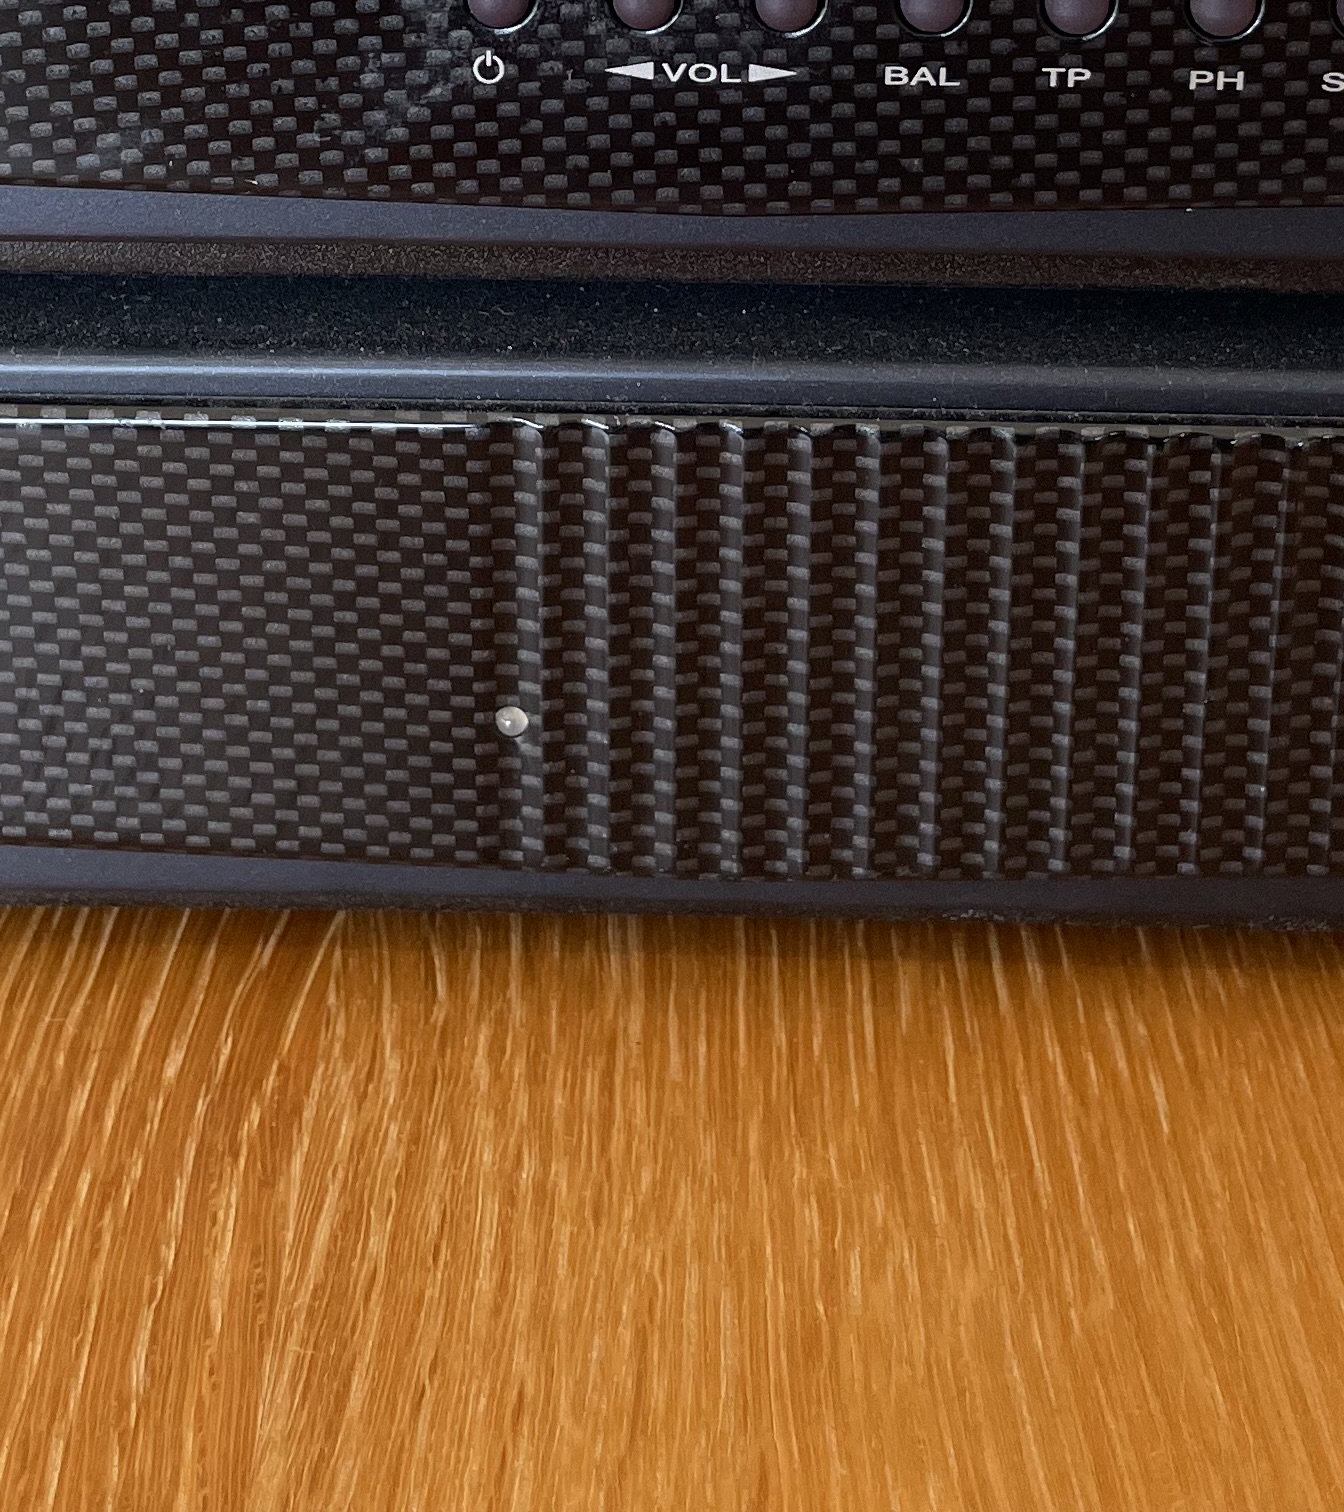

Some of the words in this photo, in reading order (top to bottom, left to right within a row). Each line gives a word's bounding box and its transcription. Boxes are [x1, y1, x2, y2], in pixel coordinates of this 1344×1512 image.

[661, 62, 742, 83] VOL
[884, 65, 960, 87] BAL
[1041, 67, 1092, 88] TP
[1189, 70, 1245, 91] PH
